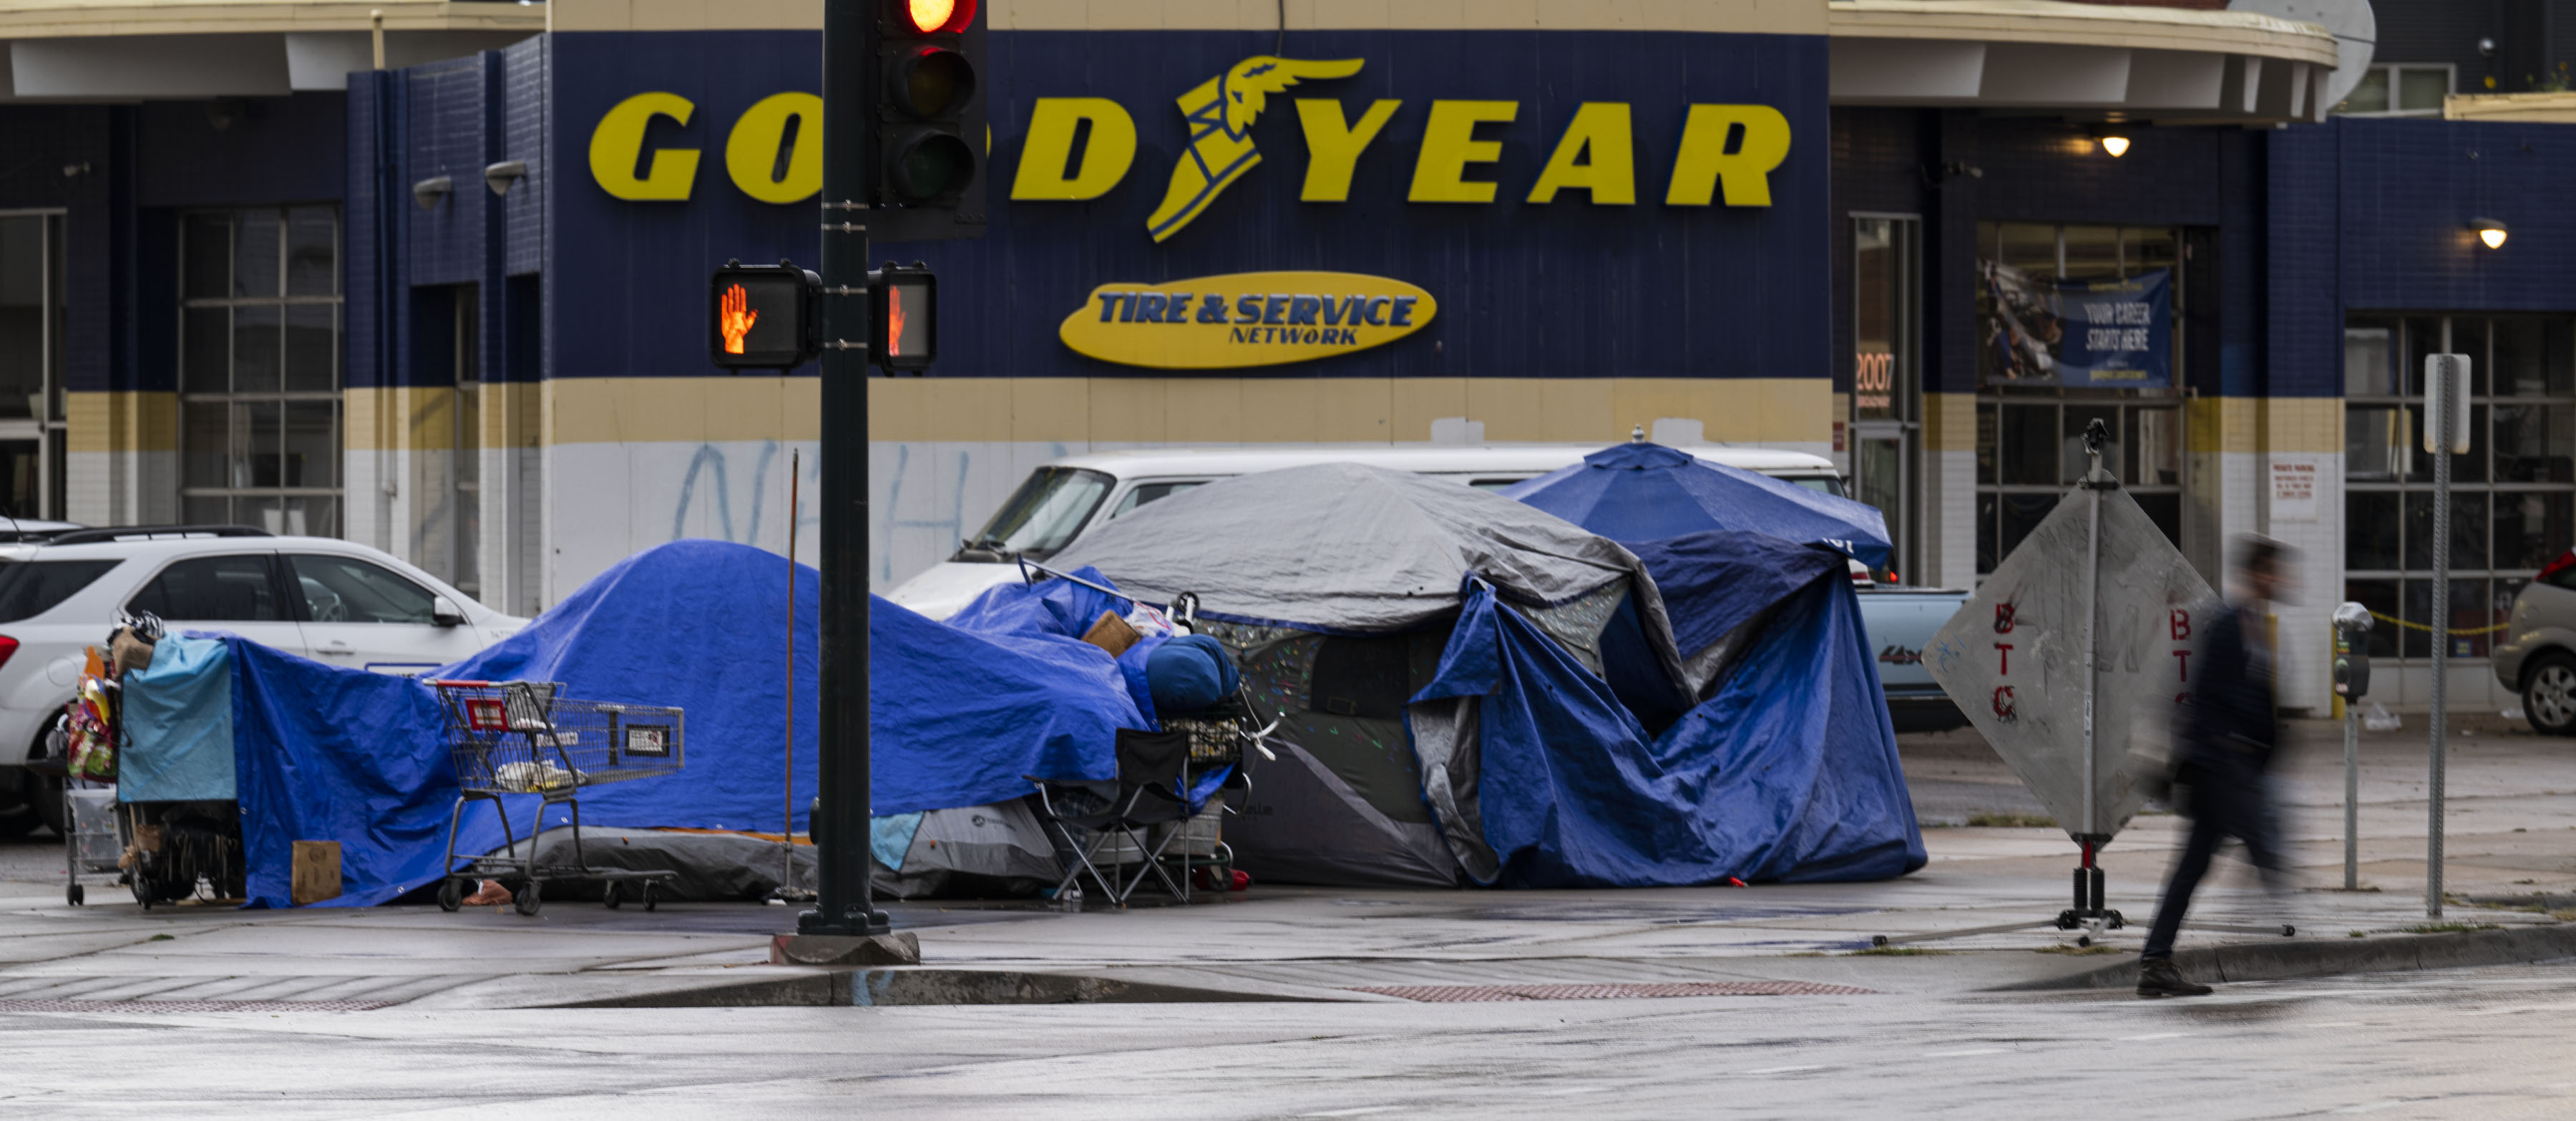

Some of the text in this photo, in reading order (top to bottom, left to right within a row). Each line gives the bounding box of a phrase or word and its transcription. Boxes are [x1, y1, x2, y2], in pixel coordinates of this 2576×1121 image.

[590, 92, 1792, 207] GOD YEAR
[1097, 292, 1418, 326] TIRE & SERVICE
[2083, 302, 2151, 326] YOUR CAREER
[1229, 326, 1357, 346] NETWORK
[2085, 329, 2150, 351] STARTS HERE
[1855, 352, 1895, 391] 2007
